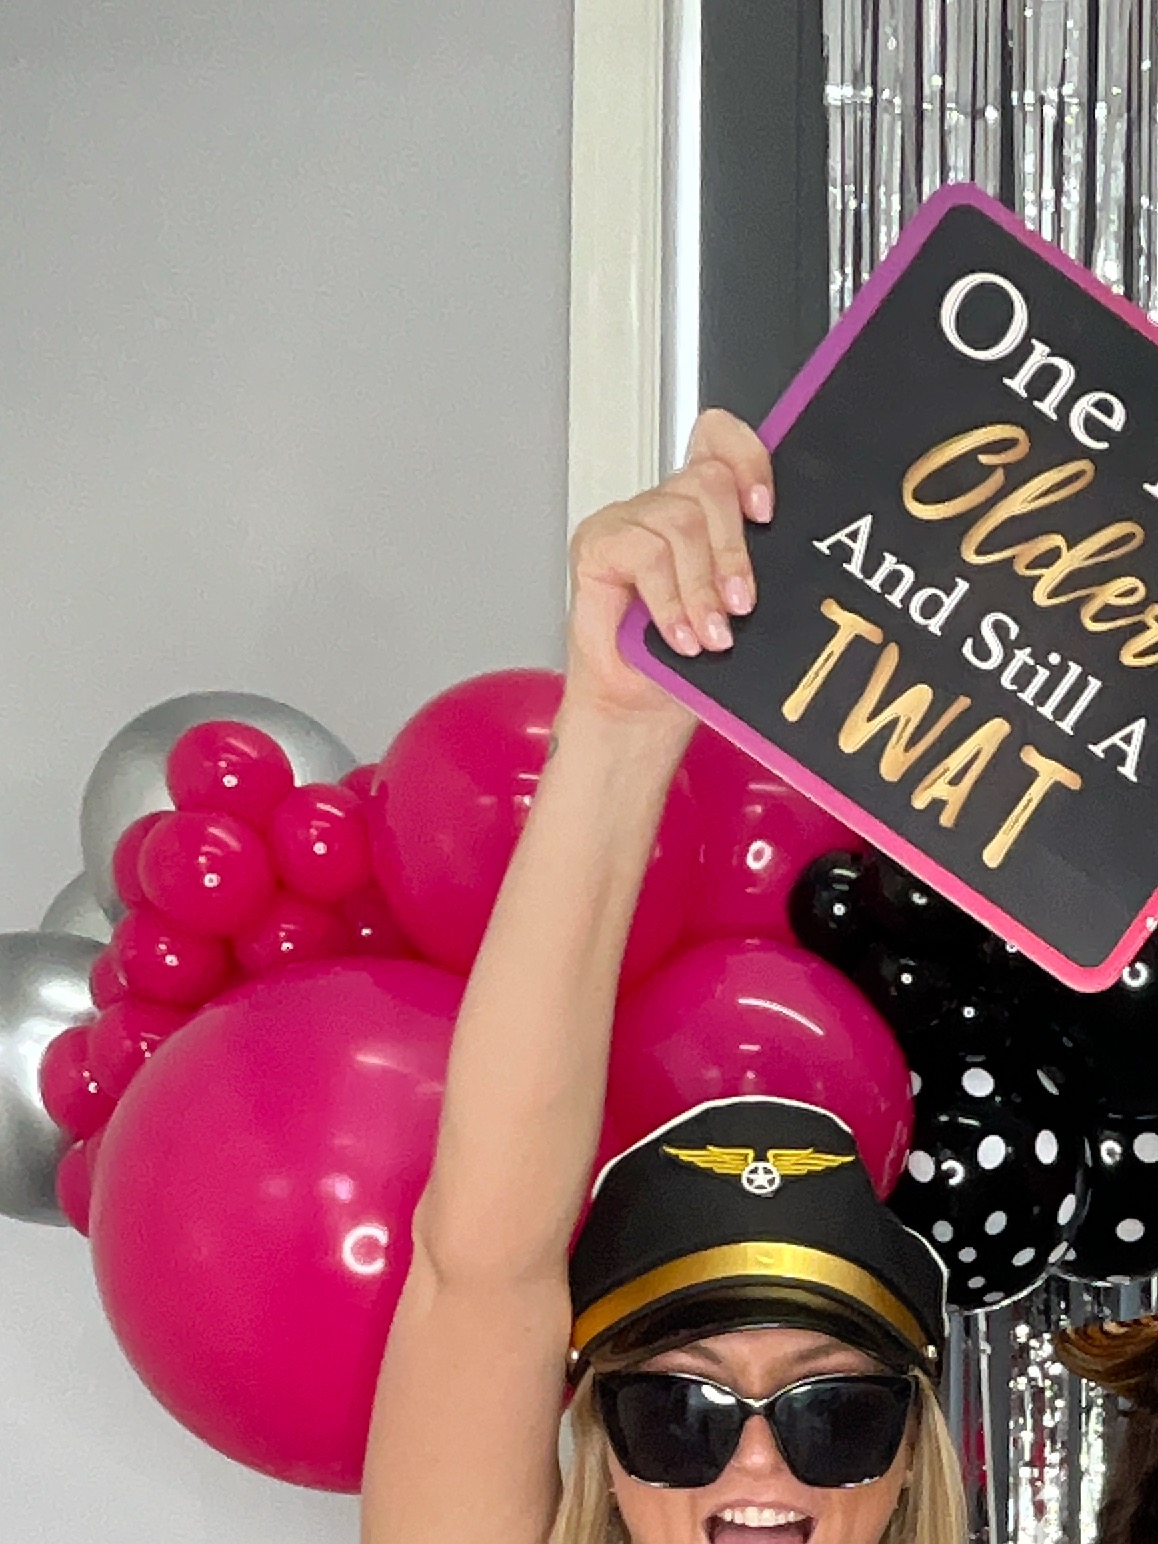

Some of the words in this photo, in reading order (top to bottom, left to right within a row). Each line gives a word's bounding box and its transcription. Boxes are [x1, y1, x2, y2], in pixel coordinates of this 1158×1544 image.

[938, 270, 1130, 452] One
[780, 597, 1083, 869] TWAT
[812, 512, 970, 638] And
[962, 611, 1101, 736] Still
[1088, 715, 1150, 783] A
